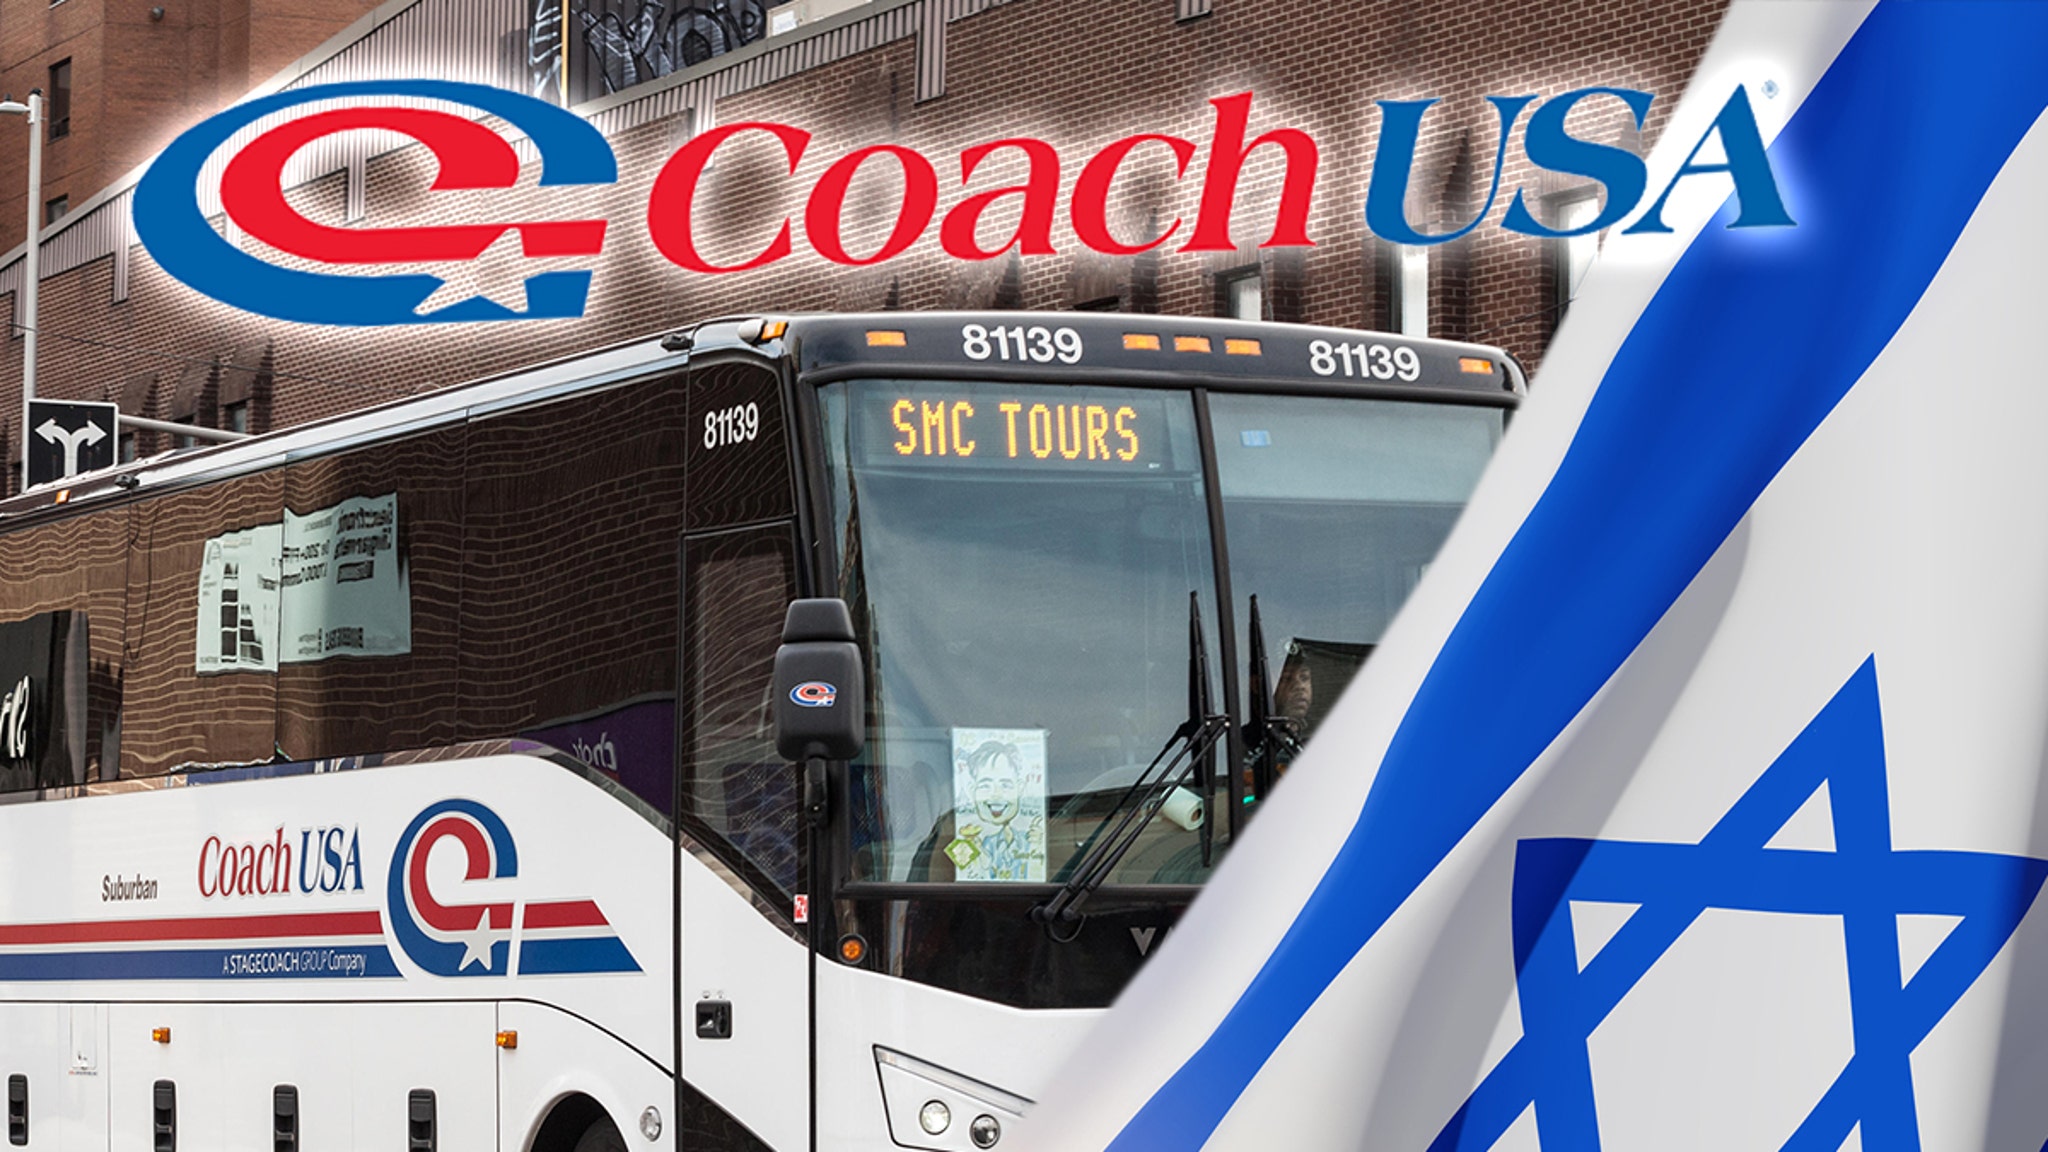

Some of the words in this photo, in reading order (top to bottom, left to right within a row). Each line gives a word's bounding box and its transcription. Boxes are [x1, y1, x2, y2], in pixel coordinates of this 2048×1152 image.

[961, 325, 1084, 364] 81139
[1308, 340, 1421, 382] 81139
[703, 402, 760, 449] 81139
[891, 399, 976, 457] SMC
[1000, 402, 1140, 461] TOURS
[198, 825, 292, 898] Coach
[299, 825, 364, 893] USA
[101, 873, 159, 902] Suburban
[222, 956, 230, 974] A
[230, 951, 300, 975] STAGECOACH
[301, 950, 328, 972] GROUP
[328, 949, 367, 976] Company
